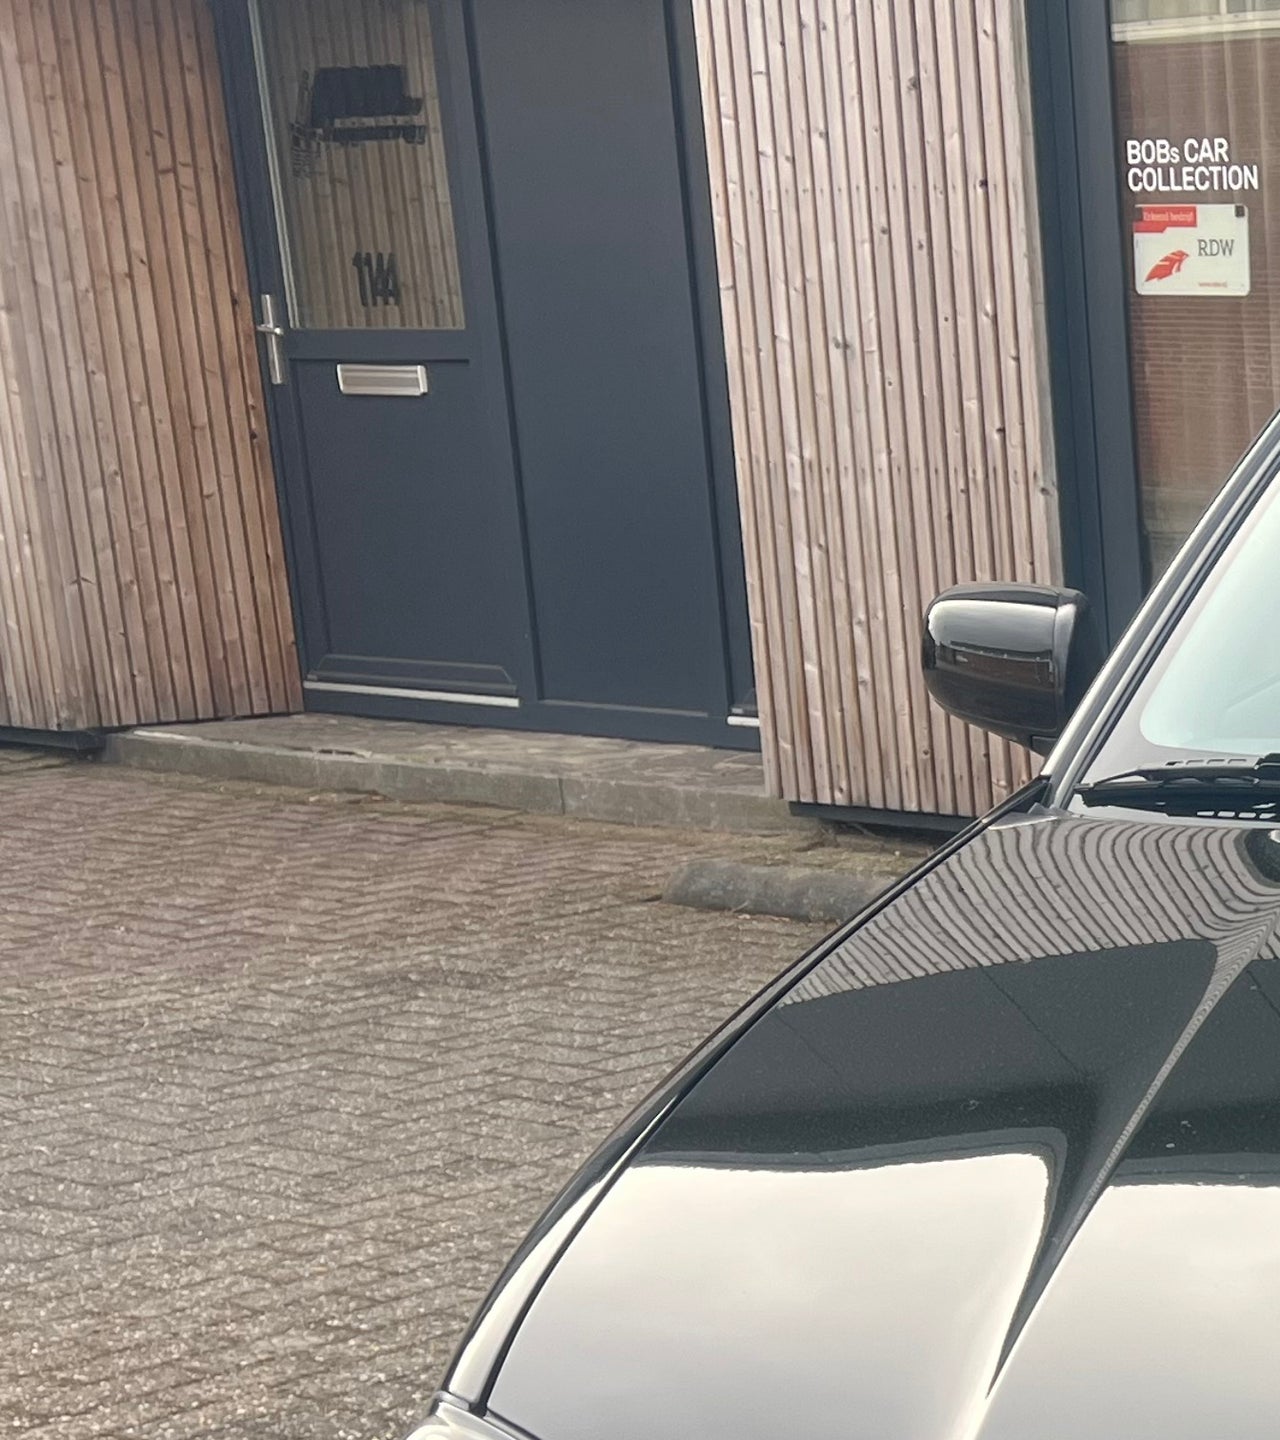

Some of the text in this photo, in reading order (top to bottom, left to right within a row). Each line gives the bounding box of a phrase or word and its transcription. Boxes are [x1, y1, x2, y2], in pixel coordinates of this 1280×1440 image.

[1126, 138, 1229, 164] BOBs CAR
[1127, 165, 1259, 192] COLLECTION
[1197, 239, 1235, 257] RDW
